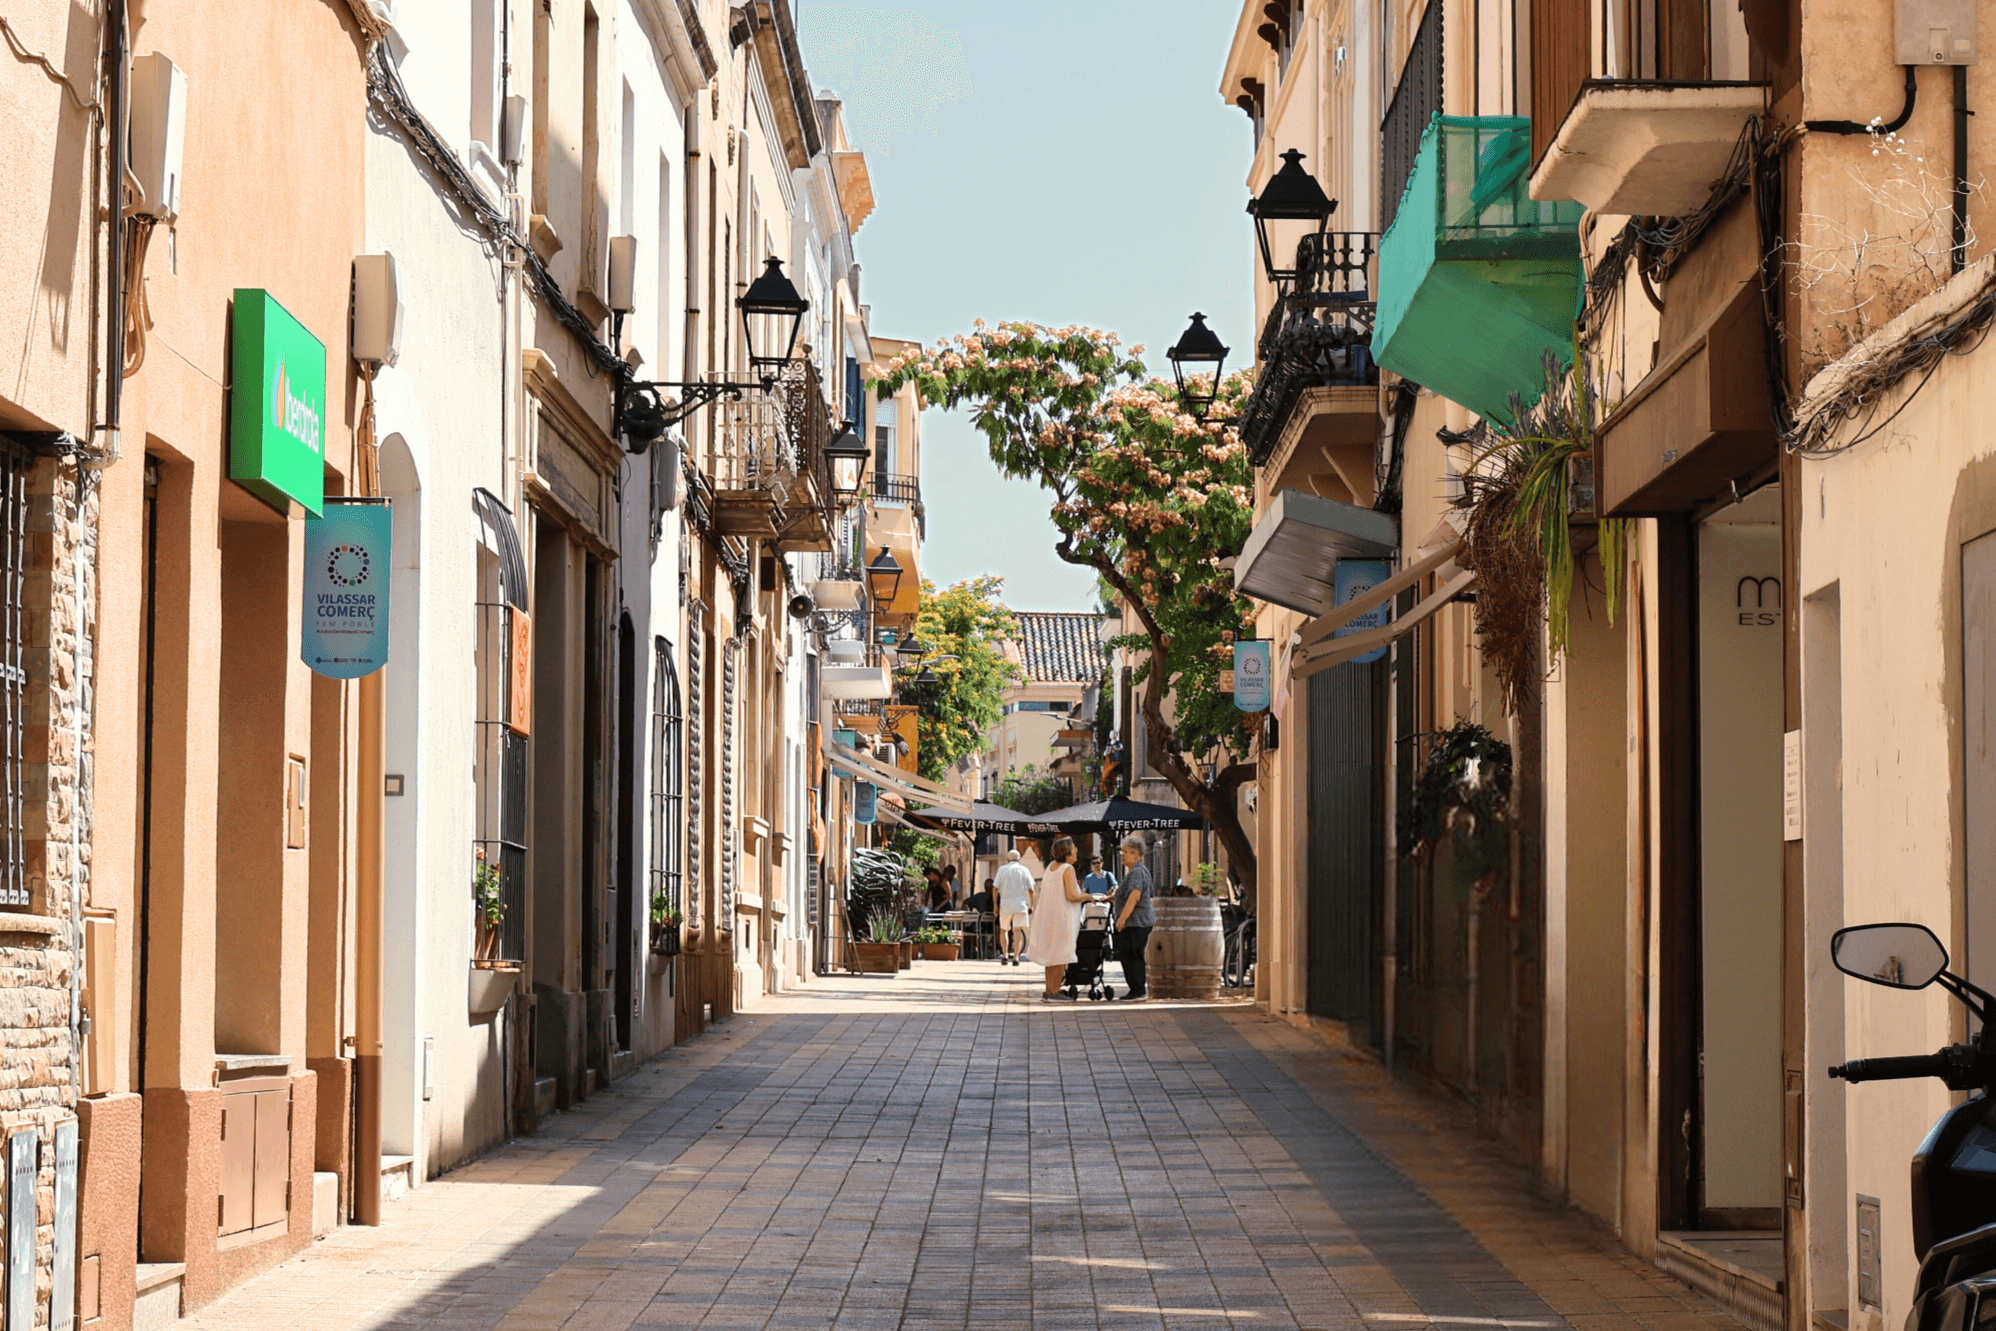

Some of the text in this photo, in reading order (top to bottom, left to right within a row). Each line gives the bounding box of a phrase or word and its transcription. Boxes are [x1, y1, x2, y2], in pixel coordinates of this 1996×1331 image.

[317, 594, 376, 605] VILASSAR
[317, 605, 375, 621] COMERÇ
[342, 620, 376, 628] POBLE
[1117, 818, 1180, 830] FEVER-TREE
